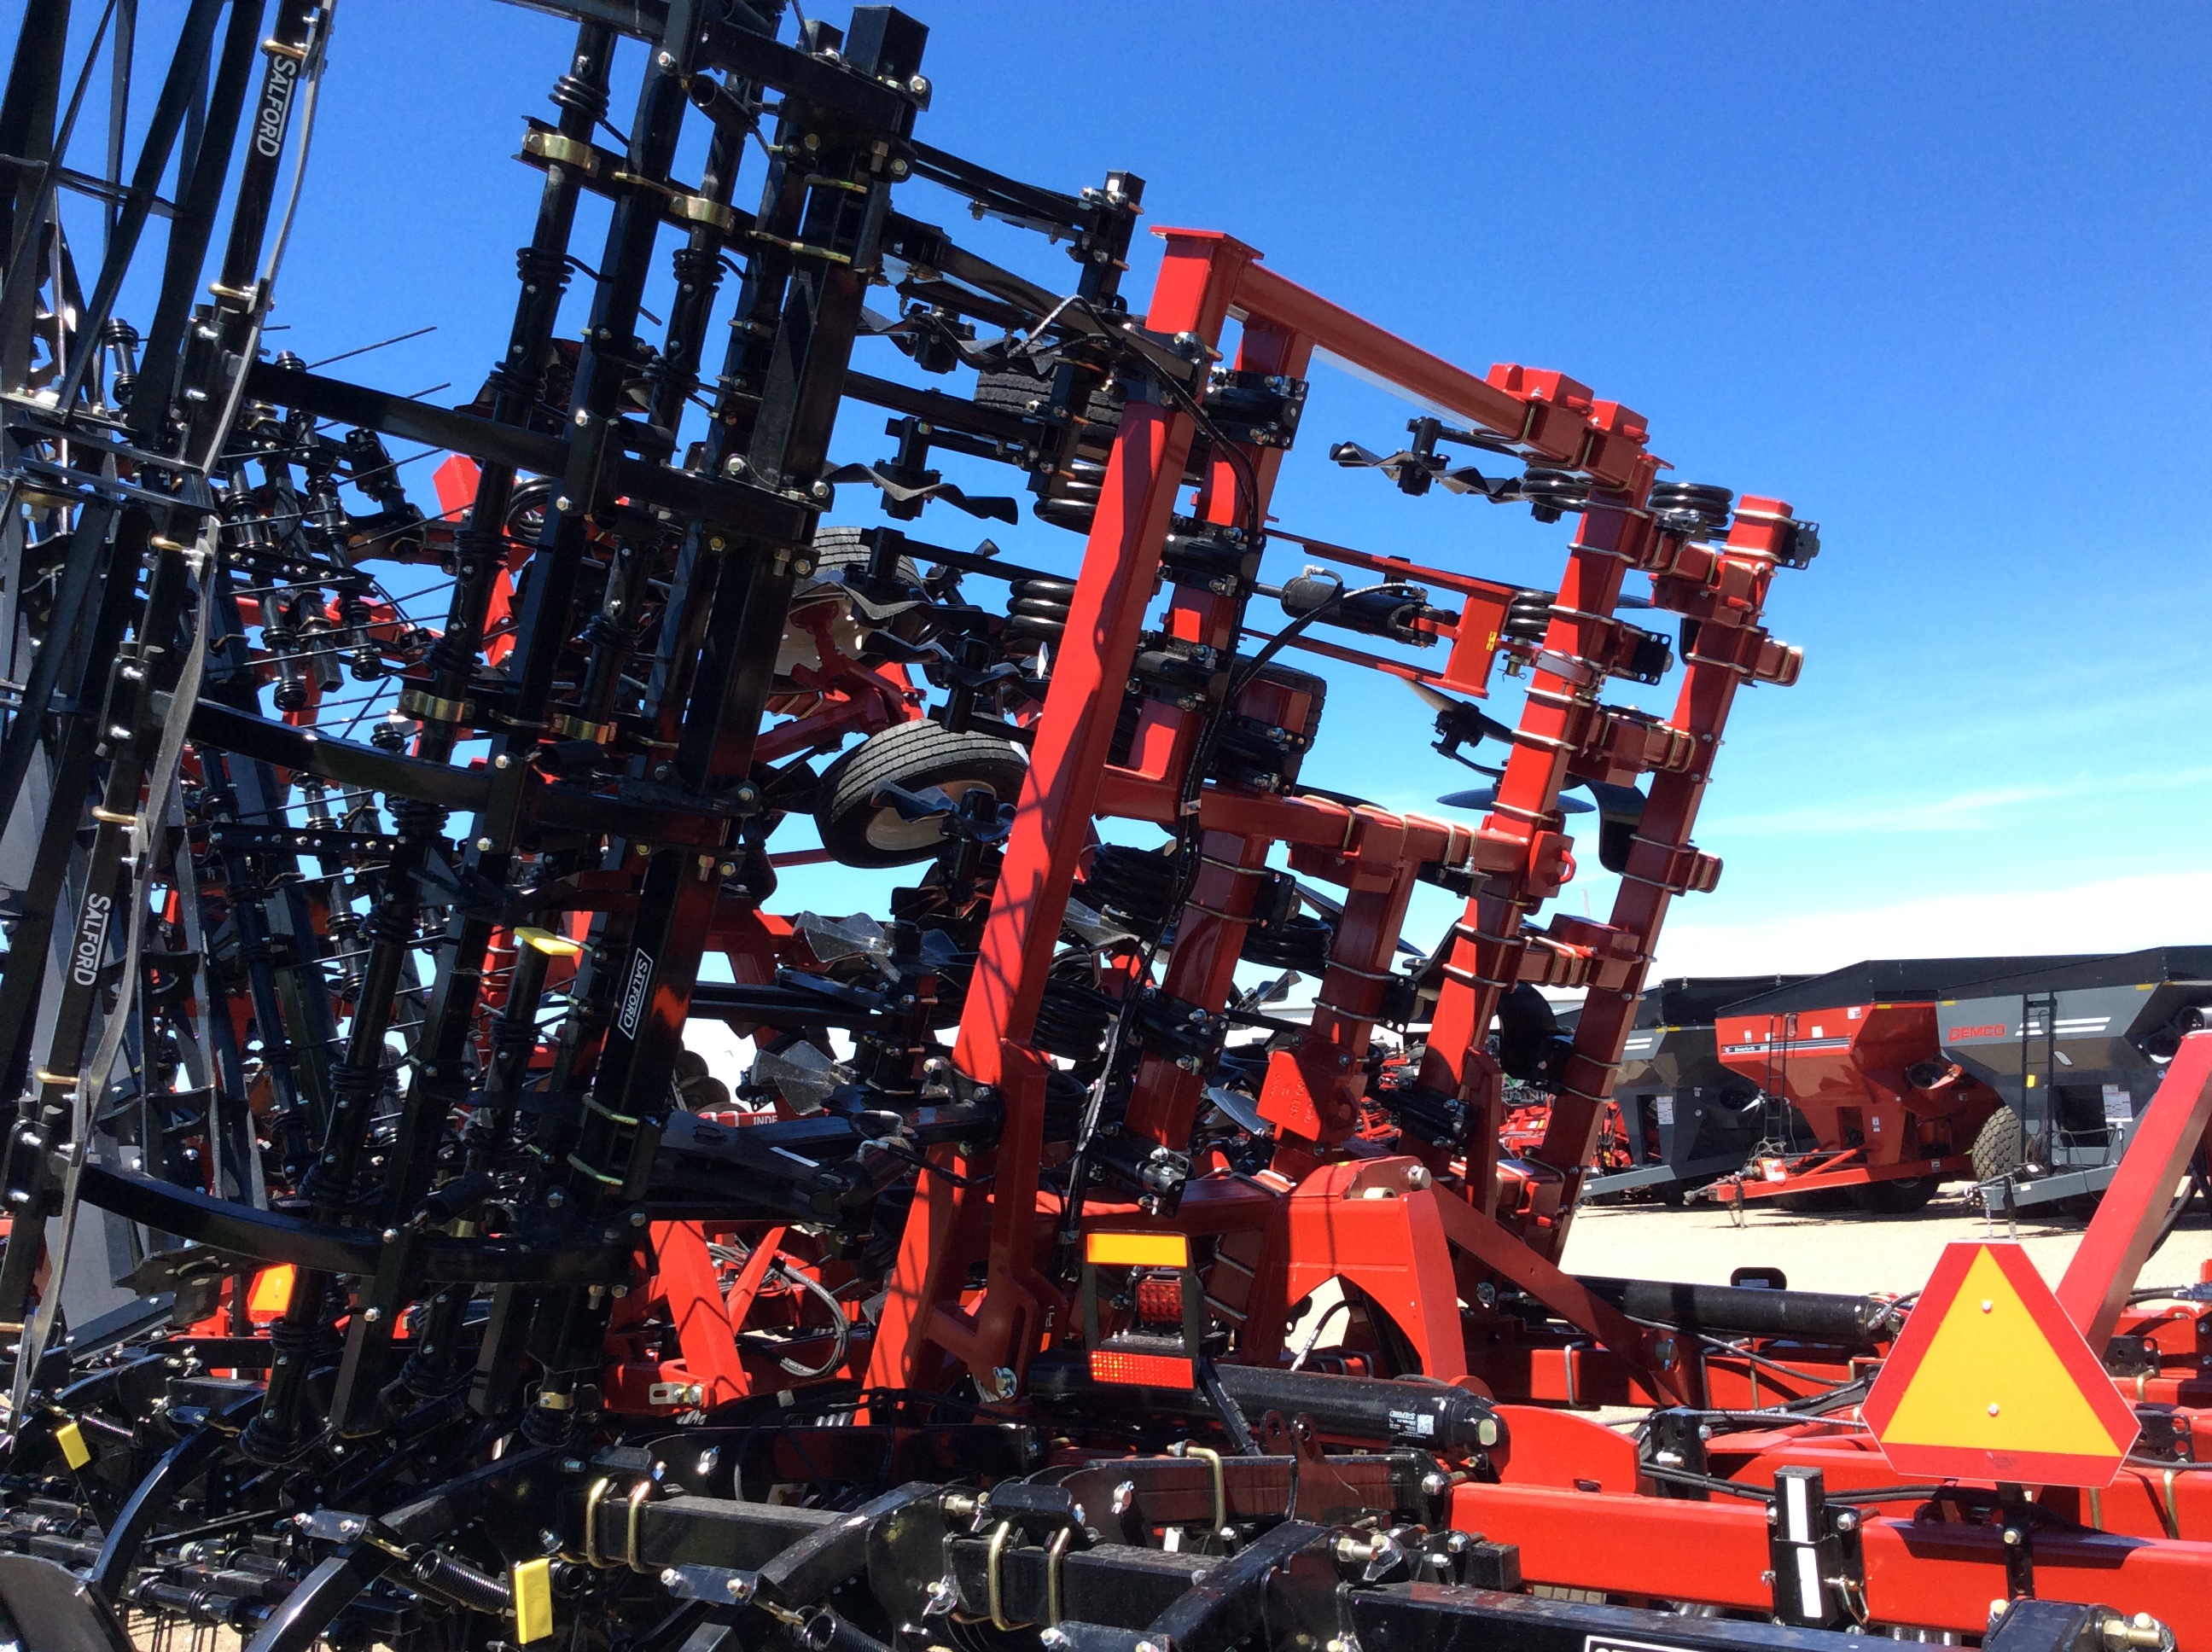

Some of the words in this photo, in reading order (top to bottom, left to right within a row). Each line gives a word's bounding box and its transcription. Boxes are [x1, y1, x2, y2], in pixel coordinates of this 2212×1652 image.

[257, 55, 297, 157] SALFORD
[73, 893, 111, 986] SALFORD
[624, 958, 649, 1028] SALFORD
[1947, 1024, 2006, 1043] DEMCO
